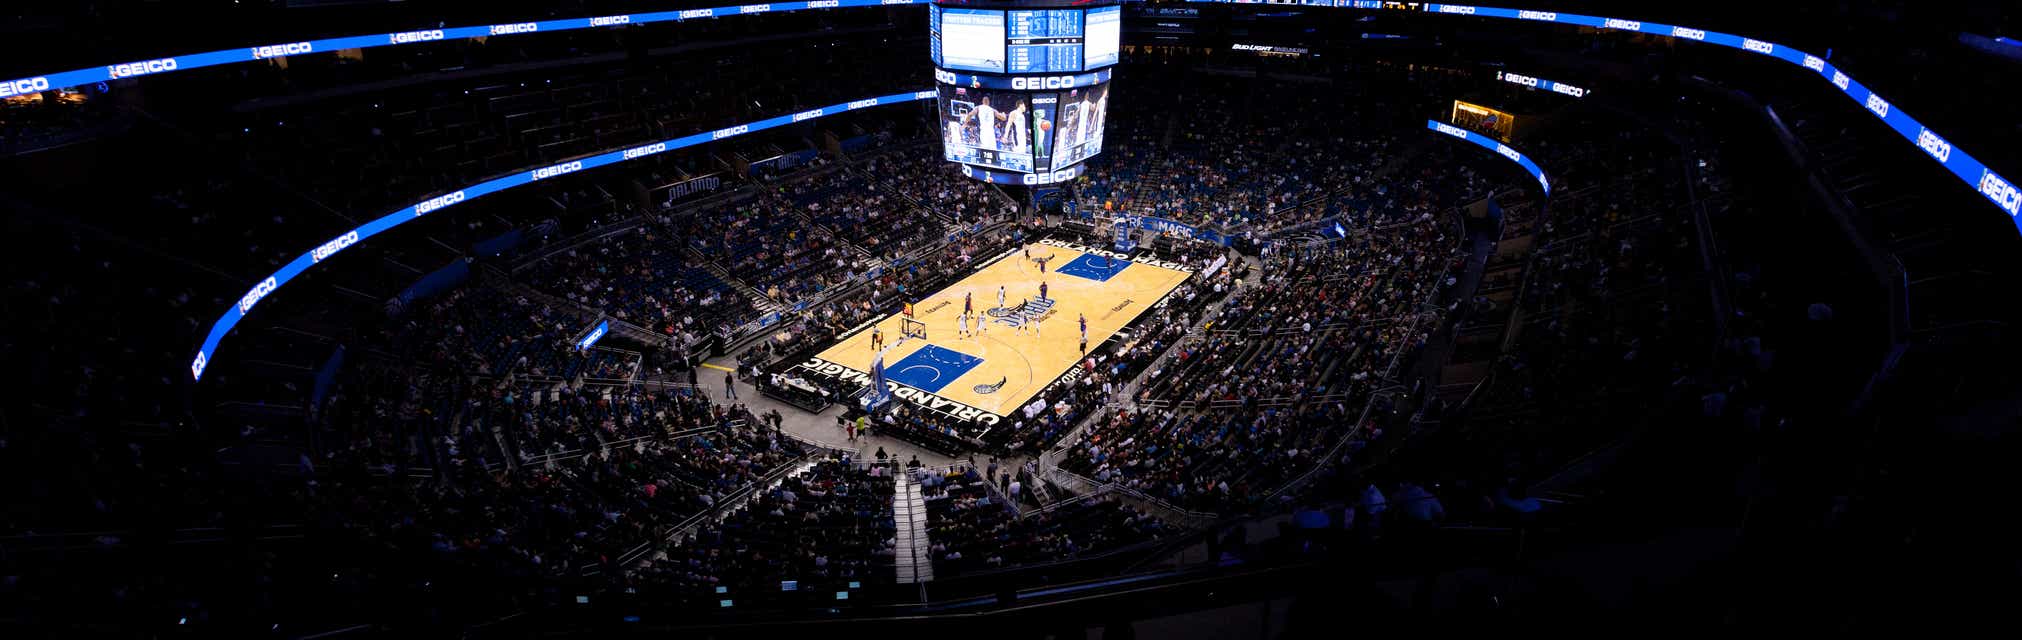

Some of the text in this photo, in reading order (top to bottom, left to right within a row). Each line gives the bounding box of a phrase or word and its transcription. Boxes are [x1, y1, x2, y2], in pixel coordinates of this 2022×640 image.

[743, 4, 770, 13] GEICO
[810, 0, 838, 8] GEICO
[1442, 5, 1475, 15] GEICO
[594, 15, 629, 25] GEICO
[683, 9, 712, 18] GEICO
[1523, 11, 1556, 20] GEICO
[494, 23, 537, 35] GEICO
[1608, 19, 1640, 30] GEICO
[395, 30, 443, 44] GEICO
[1676, 27, 1704, 40] GEICO
[259, 42, 312, 58] GEICO
[1746, 39, 1772, 53] GEICO
[118, 58, 177, 77] GEICO
[0, 77, 49, 97] EICO
[1012, 76, 1075, 90] GEICO
[1506, 73, 1583, 97] GEICO GEICO
[851, 99, 877, 109] GEICO
[1870, 94, 1888, 117] GEICO
[797, 109, 822, 121] GEICO
[716, 125, 747, 139] GEICO
[1440, 124, 1466, 138] GEICO
[628, 143, 665, 158] GEICO
[1922, 131, 1950, 162] GEICO
[537, 161, 581, 178] GEICO
[1023, 168, 1076, 185] GEICO
[1983, 173, 2022, 216] GEICO
[420, 191, 465, 213] GEICO
[1158, 221, 1193, 239] MAGIC
[318, 231, 358, 259] GEICO
[1039, 238, 1129, 260] ORLANDO
[1131, 255, 1194, 272] MAGIC
[244, 277, 276, 310] GEICO
